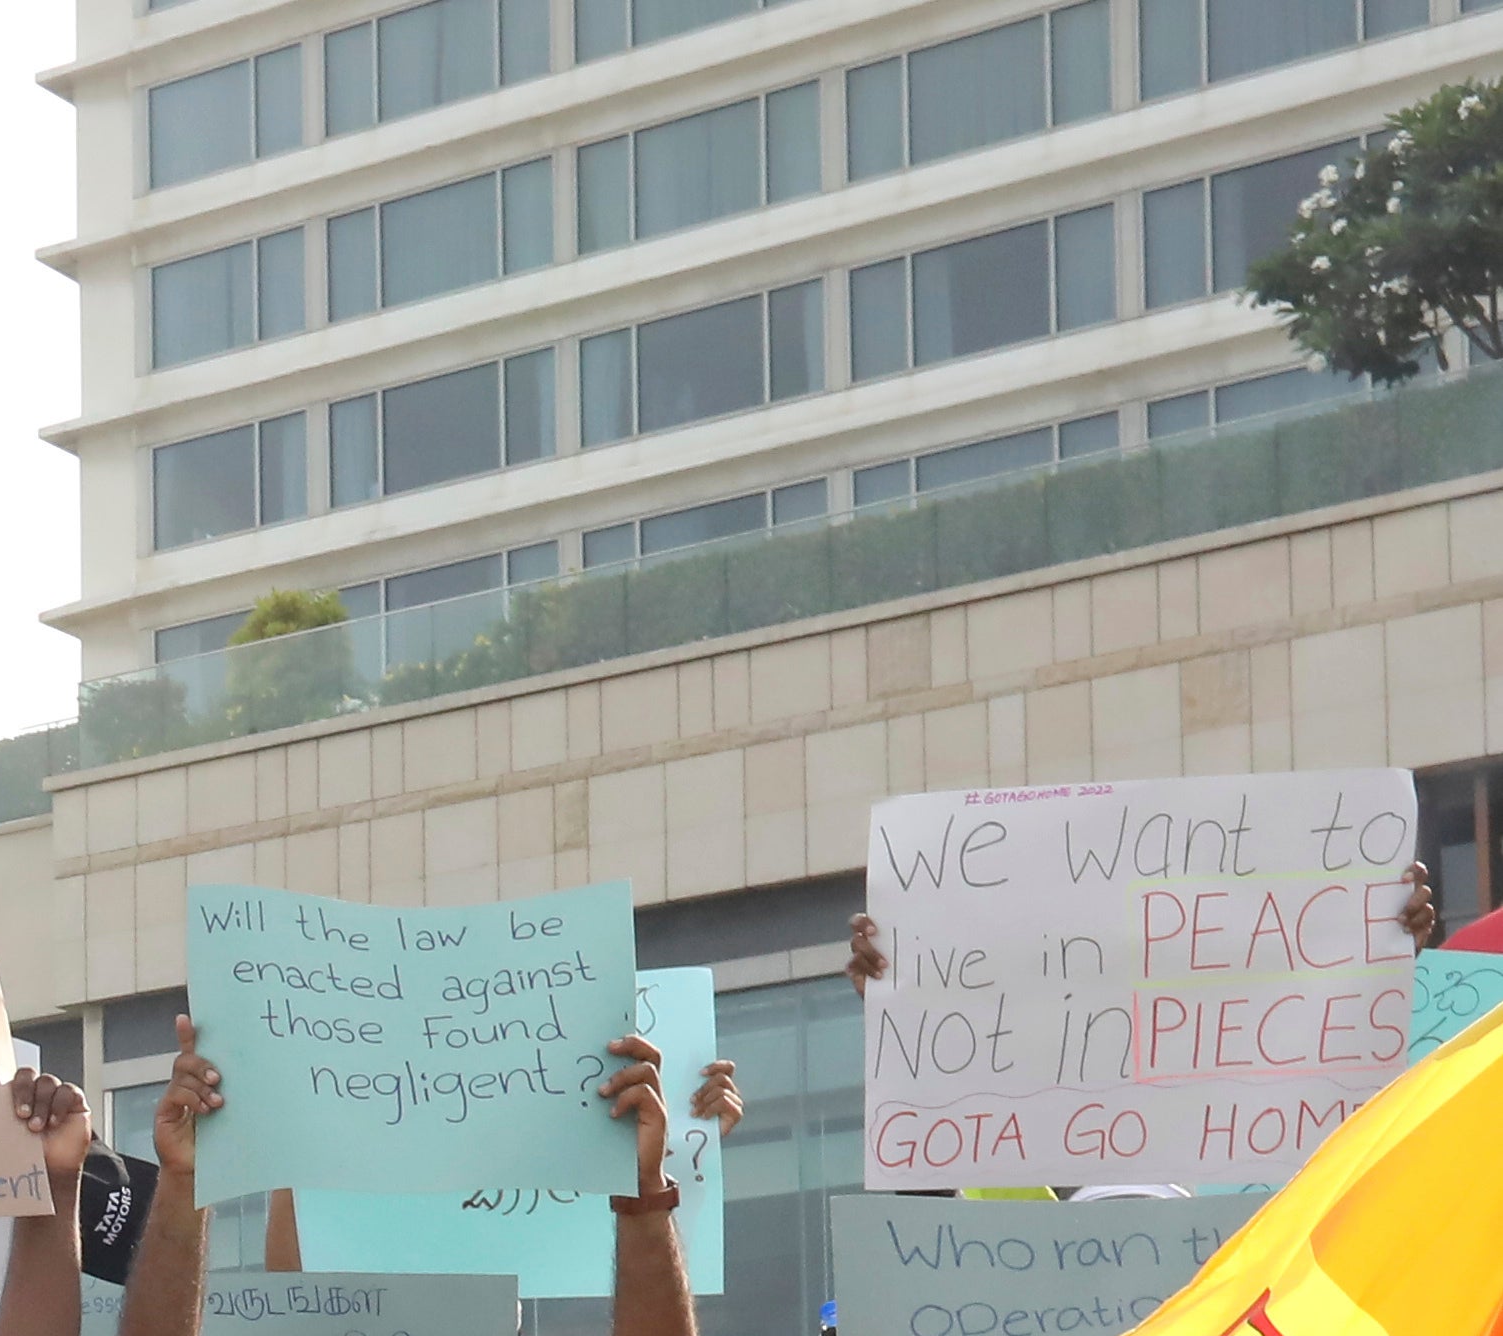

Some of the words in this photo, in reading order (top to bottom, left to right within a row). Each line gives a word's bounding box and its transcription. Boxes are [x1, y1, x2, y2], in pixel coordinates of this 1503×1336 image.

[1311, 793, 1408, 877] to
[200, 901, 266, 935] Will
[296, 904, 369, 952] the
[397, 919, 468, 952] law
[510, 910, 564, 942] be
[891, 927, 996, 991] live
[1041, 932, 1103, 979] in
[1141, 880, 1416, 979] PEACE
[233, 957, 404, 1002] enacted
[441, 950, 597, 1014] against
[260, 998, 384, 1045] those
[1148, 989, 1406, 1069] PIECES
[875, 1111, 1026, 1169] GOTA
[1064, 1103, 1147, 1160] GO
[1199, 1100, 1364, 1161] HOM
[94, 1190, 121, 1233] TATA
[102, 1186, 132, 1246] MOTORS
[887, 1221, 1035, 1272] Who
[1056, 1231, 1160, 1271] ran
